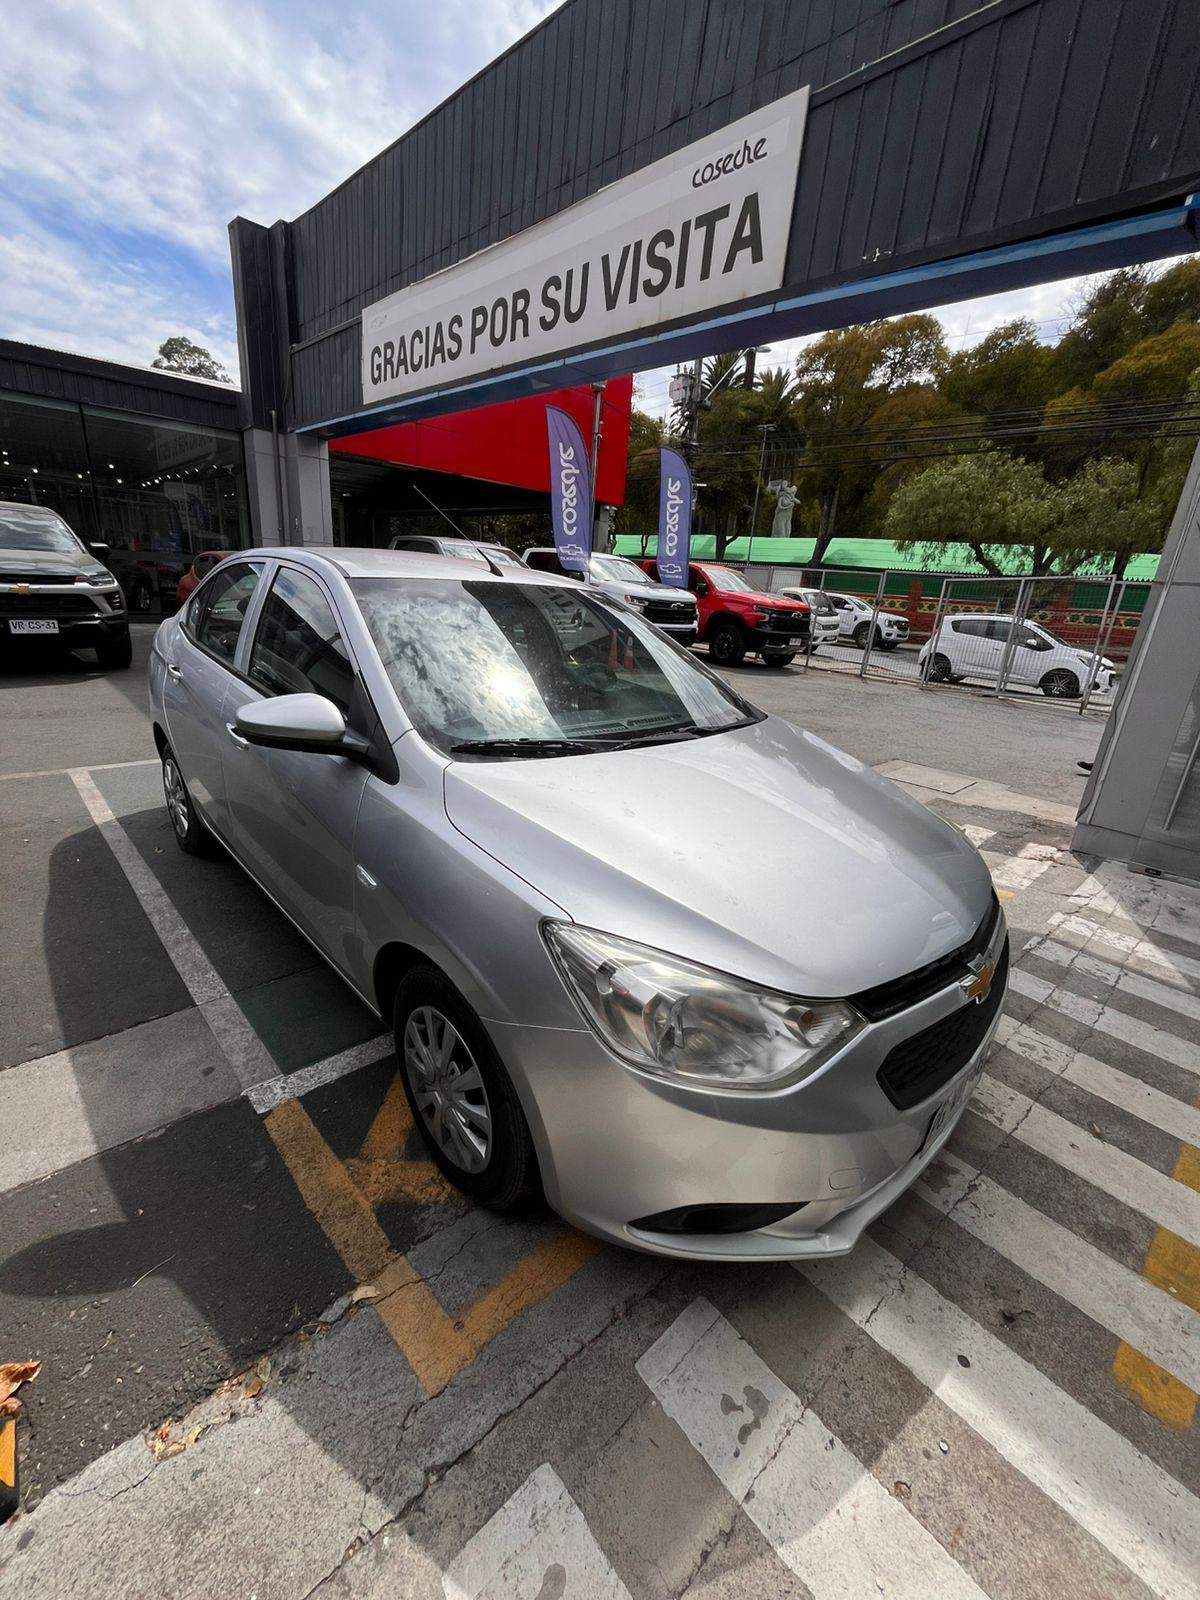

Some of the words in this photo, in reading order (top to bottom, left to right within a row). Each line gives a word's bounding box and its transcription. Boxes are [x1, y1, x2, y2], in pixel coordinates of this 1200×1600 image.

[692, 137, 768, 189] coseche
[370, 314, 463, 387] GRACIAS
[469, 288, 531, 355] POR
[538, 261, 590, 332] SU
[601, 191, 764, 312] VISITA
[559, 441, 580, 536] coseche
[665, 477, 684, 557] coseche
